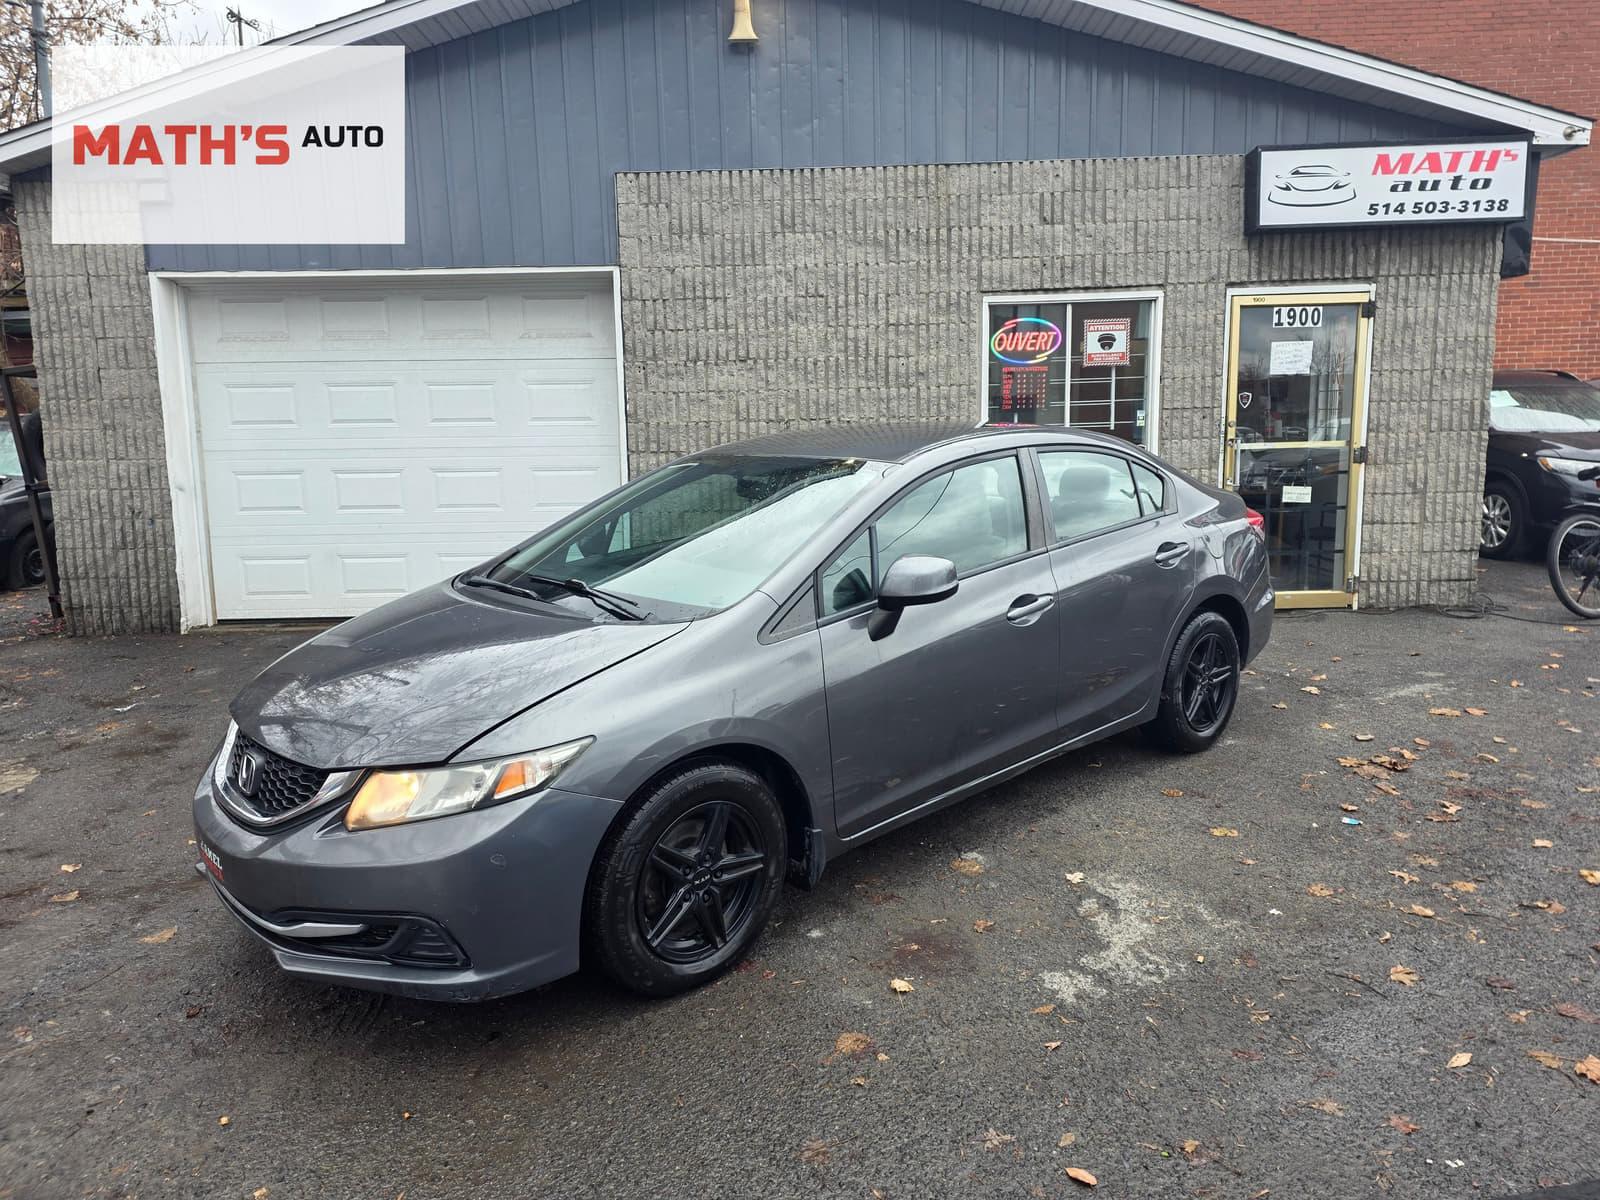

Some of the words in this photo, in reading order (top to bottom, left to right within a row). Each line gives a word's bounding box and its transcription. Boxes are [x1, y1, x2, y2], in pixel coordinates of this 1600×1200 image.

[1389, 175, 1493, 192] auto
[1367, 202, 1406, 216] 514
[1411, 199, 1510, 215] 503-3138
[1274, 307, 1321, 326] 1900
[994, 331, 1057, 352] OUVERT
